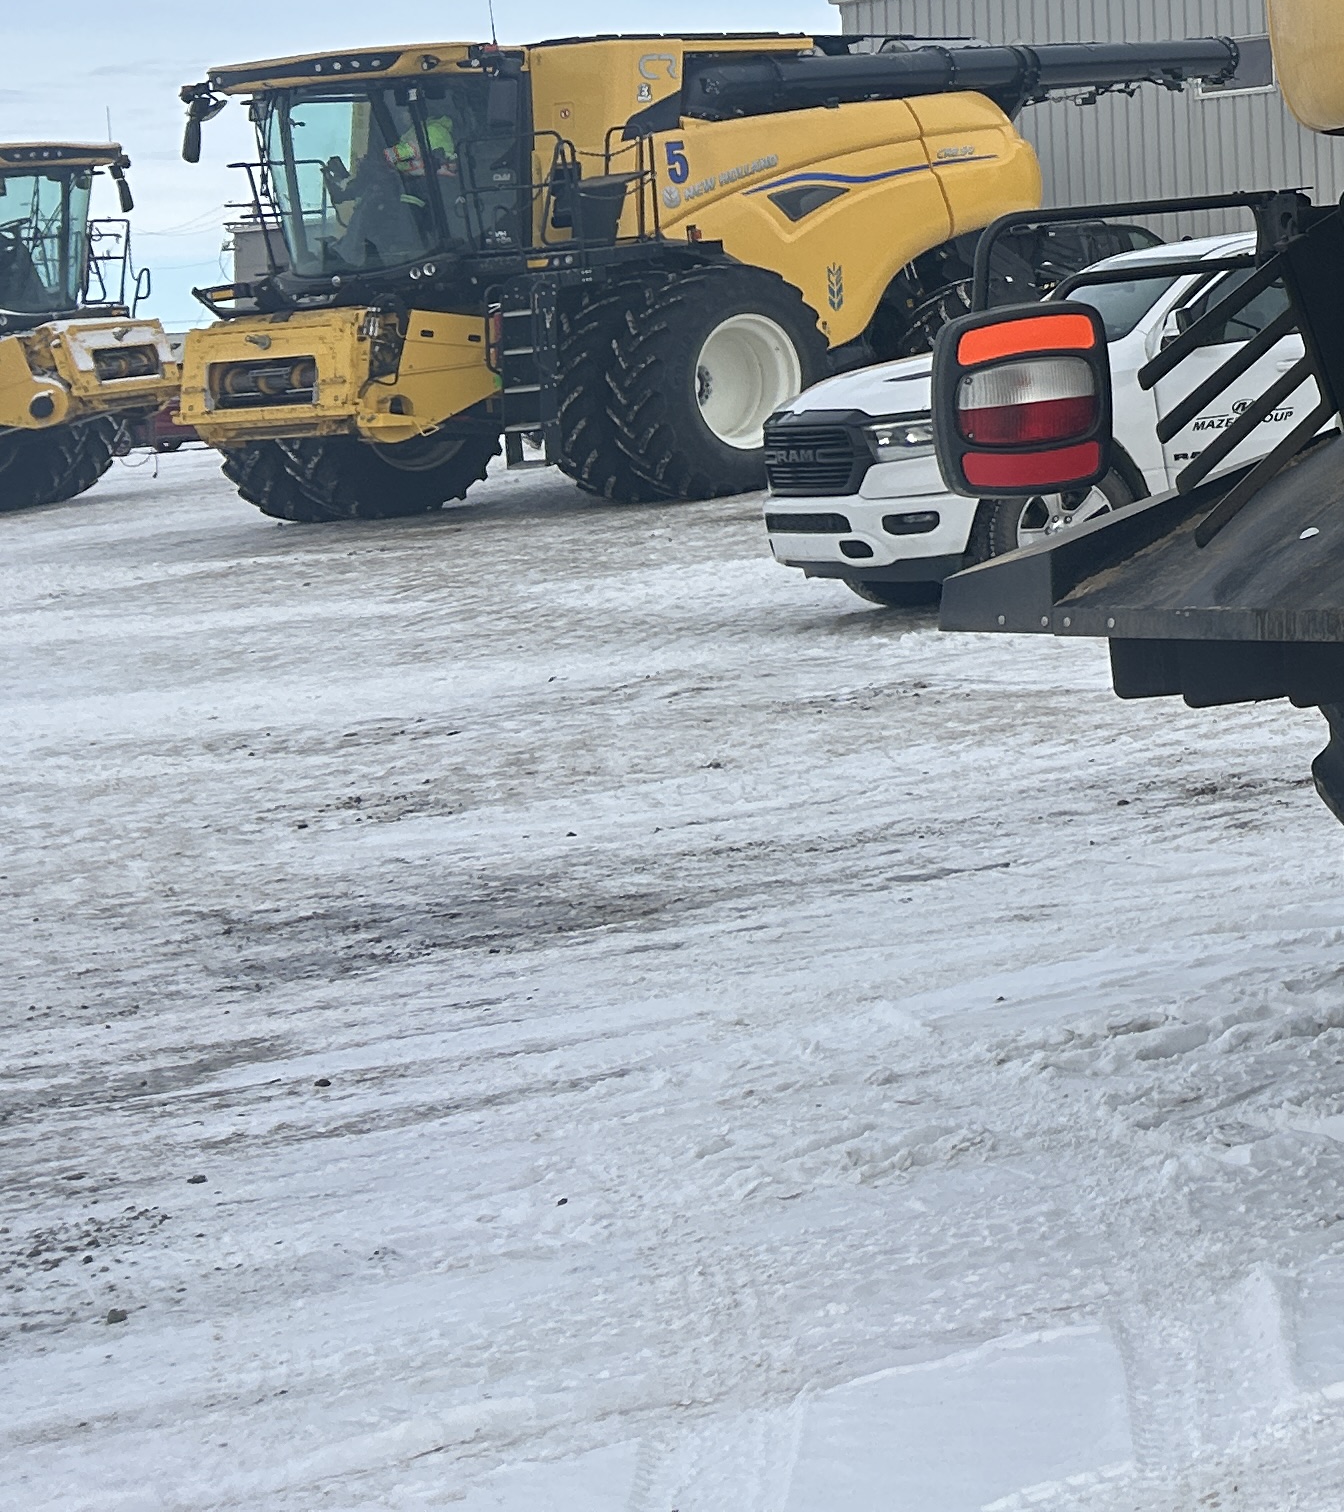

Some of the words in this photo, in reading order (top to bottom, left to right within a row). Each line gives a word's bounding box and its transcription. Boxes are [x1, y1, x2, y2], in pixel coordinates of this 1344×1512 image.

[639, 53, 677, 80] CR
[665, 140, 689, 184] 5
[684, 176, 715, 201] NEW
[719, 154, 778, 186] HOLLAND
[777, 449, 814, 463] RAM
